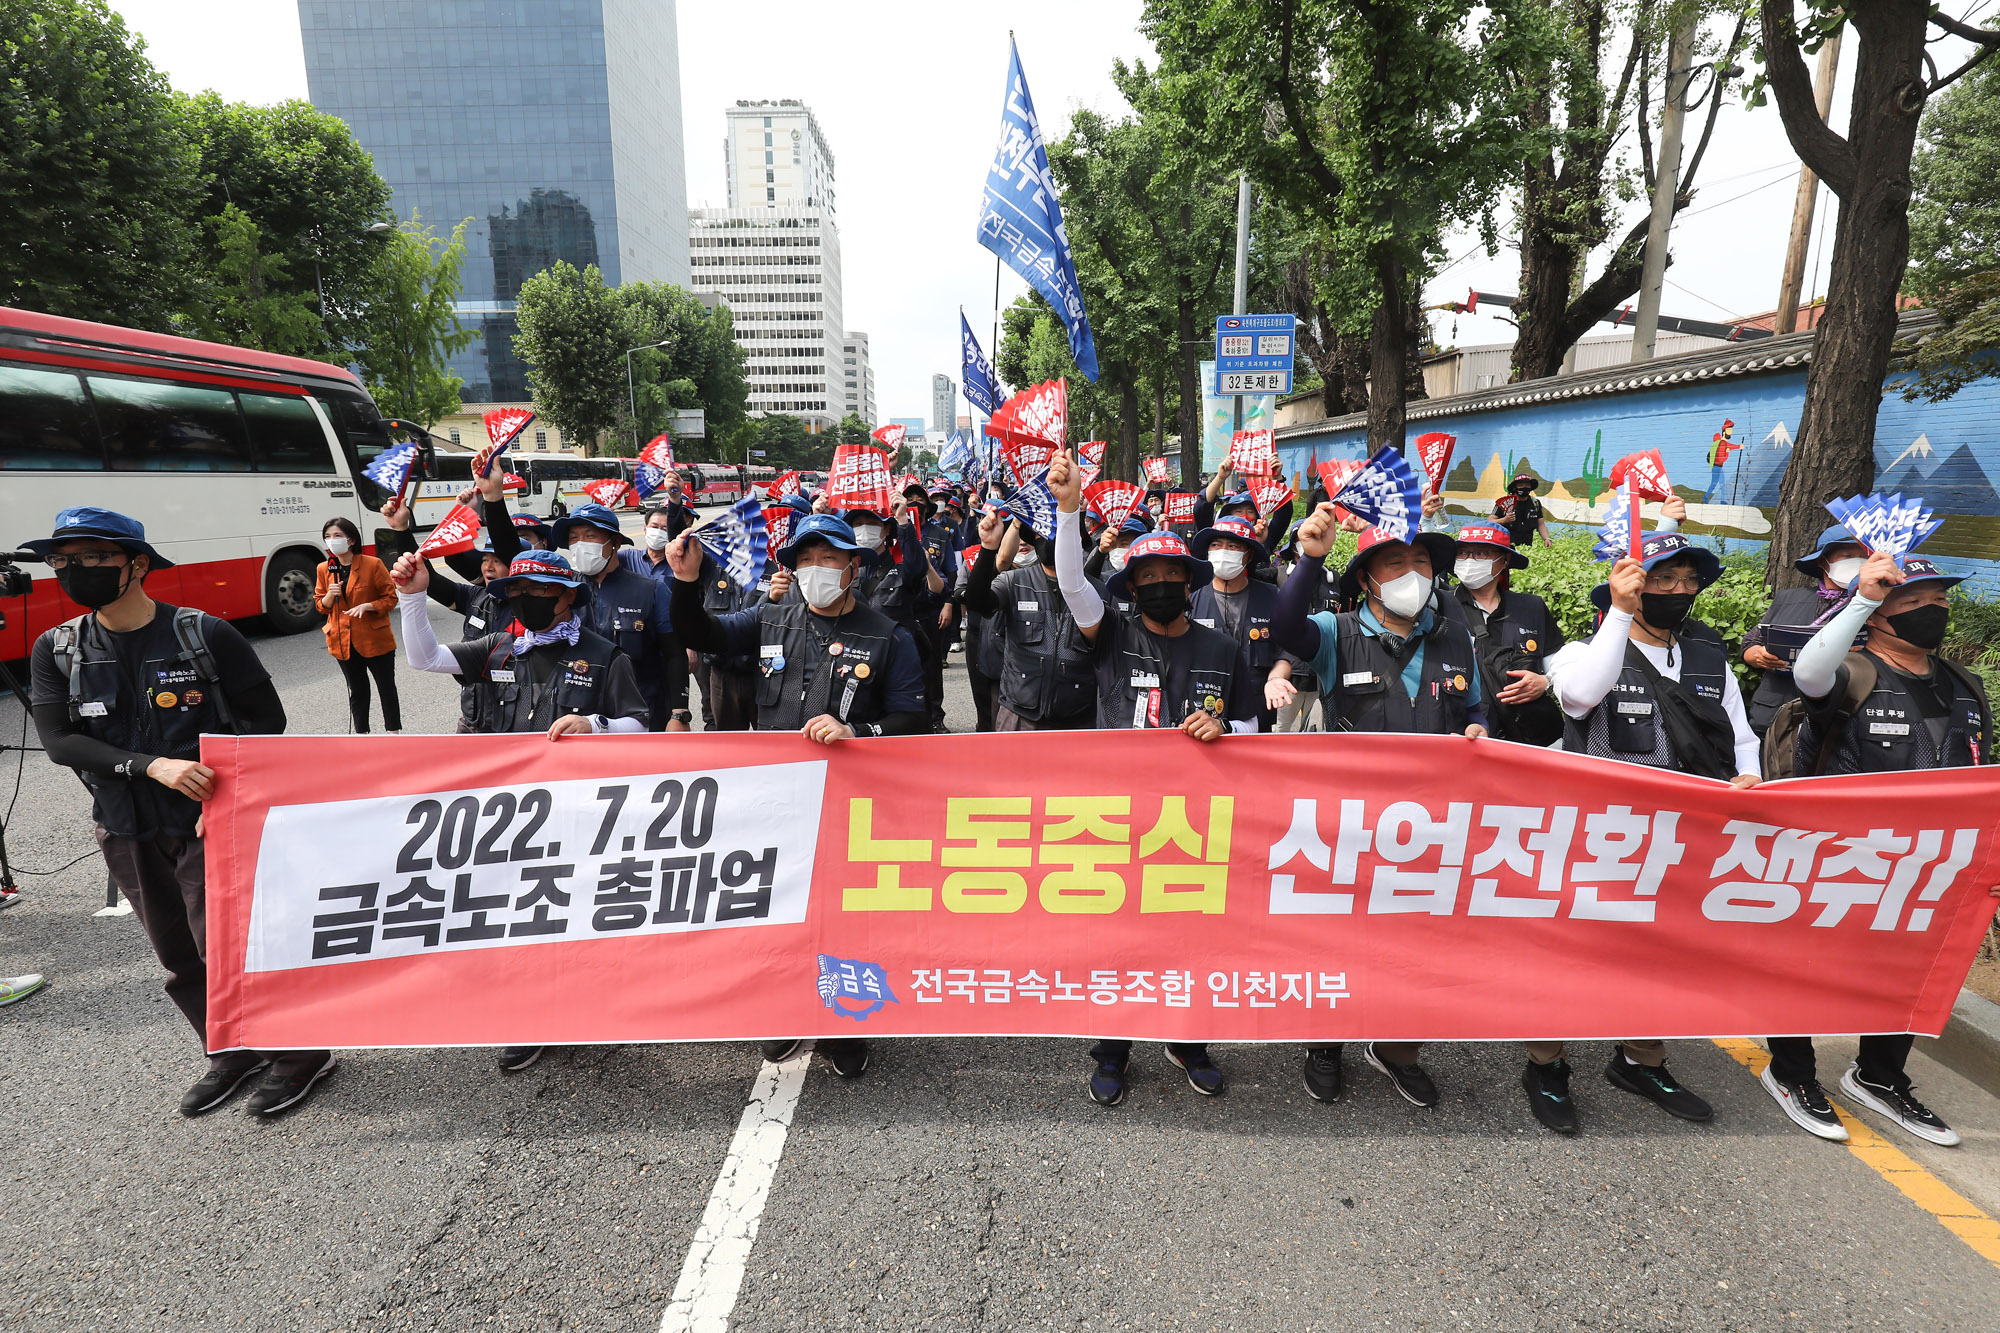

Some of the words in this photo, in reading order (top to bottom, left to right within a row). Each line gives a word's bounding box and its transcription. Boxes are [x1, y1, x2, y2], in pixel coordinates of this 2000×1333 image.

[834, 450, 884, 478] 노동중심
[831, 470, 892, 496] 산업전환!
[1096, 490, 1139, 516] 노동중심
[1470, 529, 1494, 540] 투쟁
[1866, 708, 1885, 717] 단결
[1888, 709, 1905, 718] 투쟁
[396, 787, 562, 873] 2022.
[590, 776, 719, 857] 7.20
[842, 796, 1234, 915] 노동중심
[1268, 798, 1685, 923] 산업전환
[1701, 819, 1980, 932] 쟁취!
[311, 864, 574, 960] 금속노조
[591, 846, 778, 932] 총파업
[840, 963, 883, 1000] 금속
[910, 968, 1195, 1008] 전국금속노동조합
[1207, 971, 1350, 1010] 인천지부
